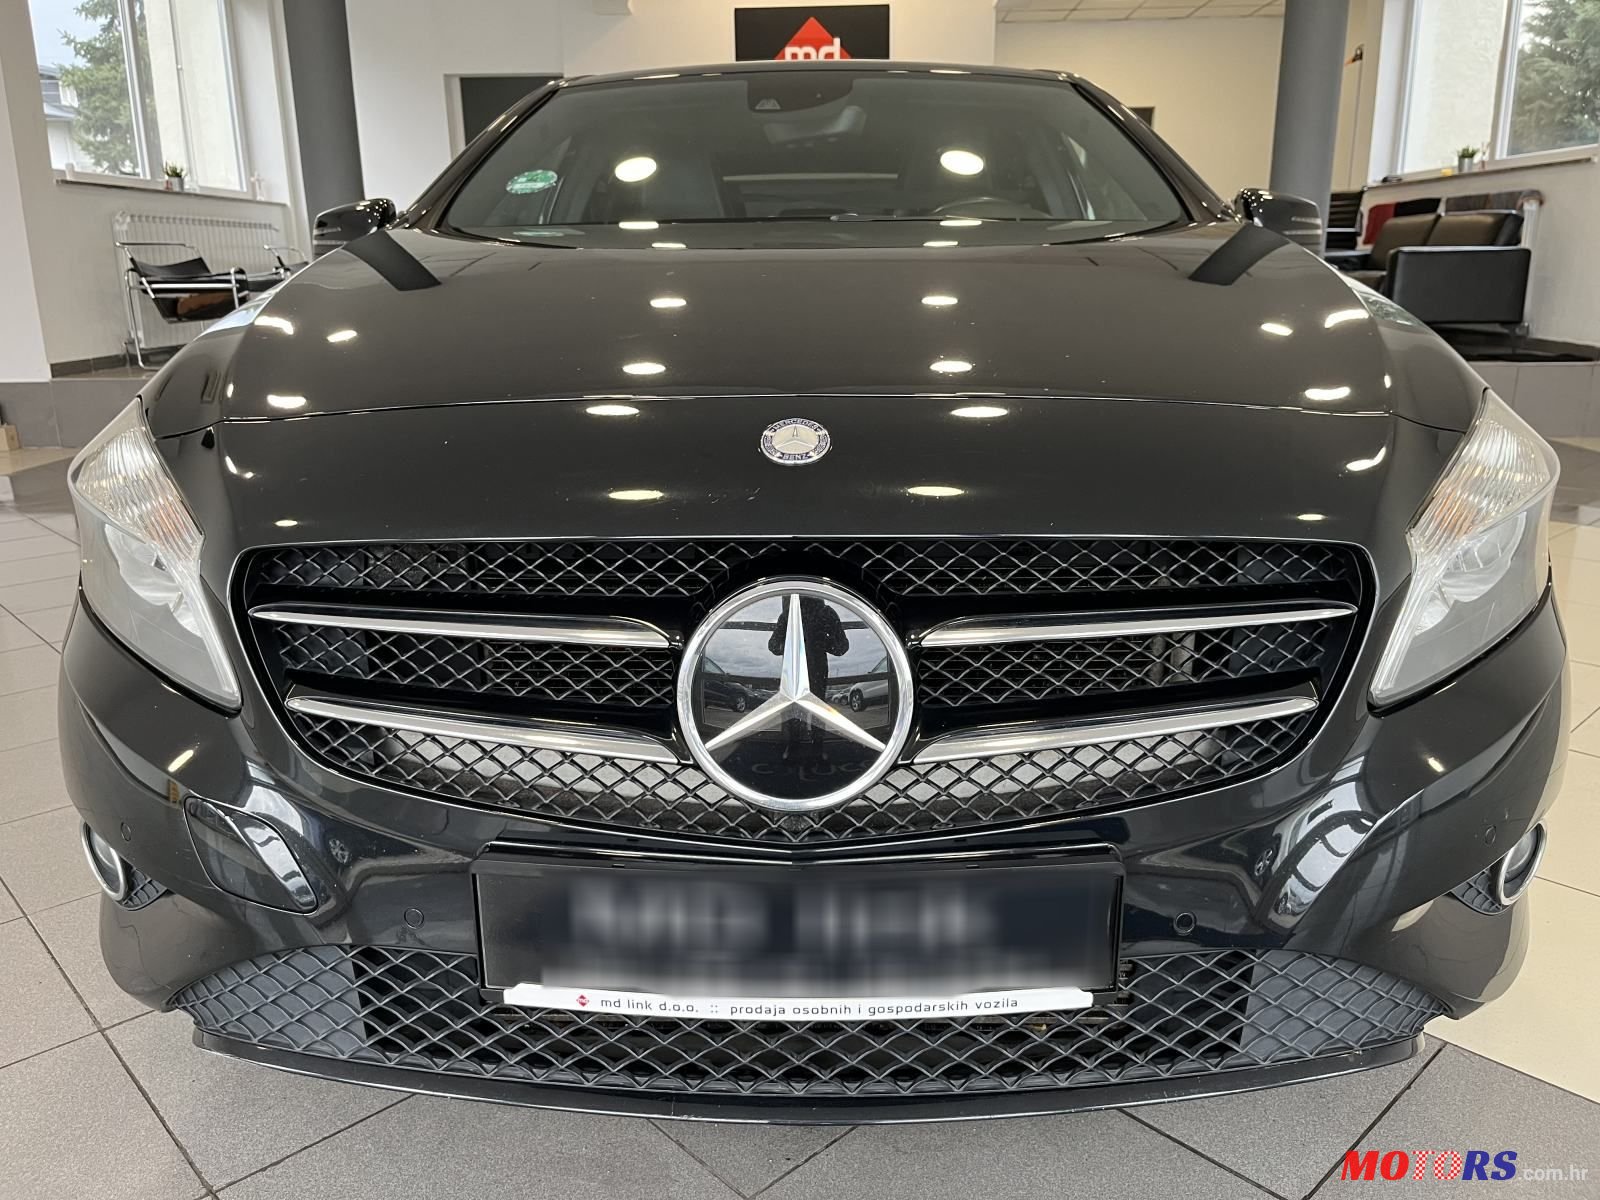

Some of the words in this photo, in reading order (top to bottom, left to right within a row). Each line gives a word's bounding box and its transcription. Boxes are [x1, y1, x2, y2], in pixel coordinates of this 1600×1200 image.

[785, 37, 841, 61] md
[600, 998, 621, 1009] md
[627, 999, 653, 1011] link
[659, 1001, 699, 1013] d.o.o.
[730, 1003, 786, 1017] prodaja
[792, 1001, 852, 1015] osobnih
[868, 1001, 968, 1016] gospodarskih
[975, 998, 1018, 1009] vozila
